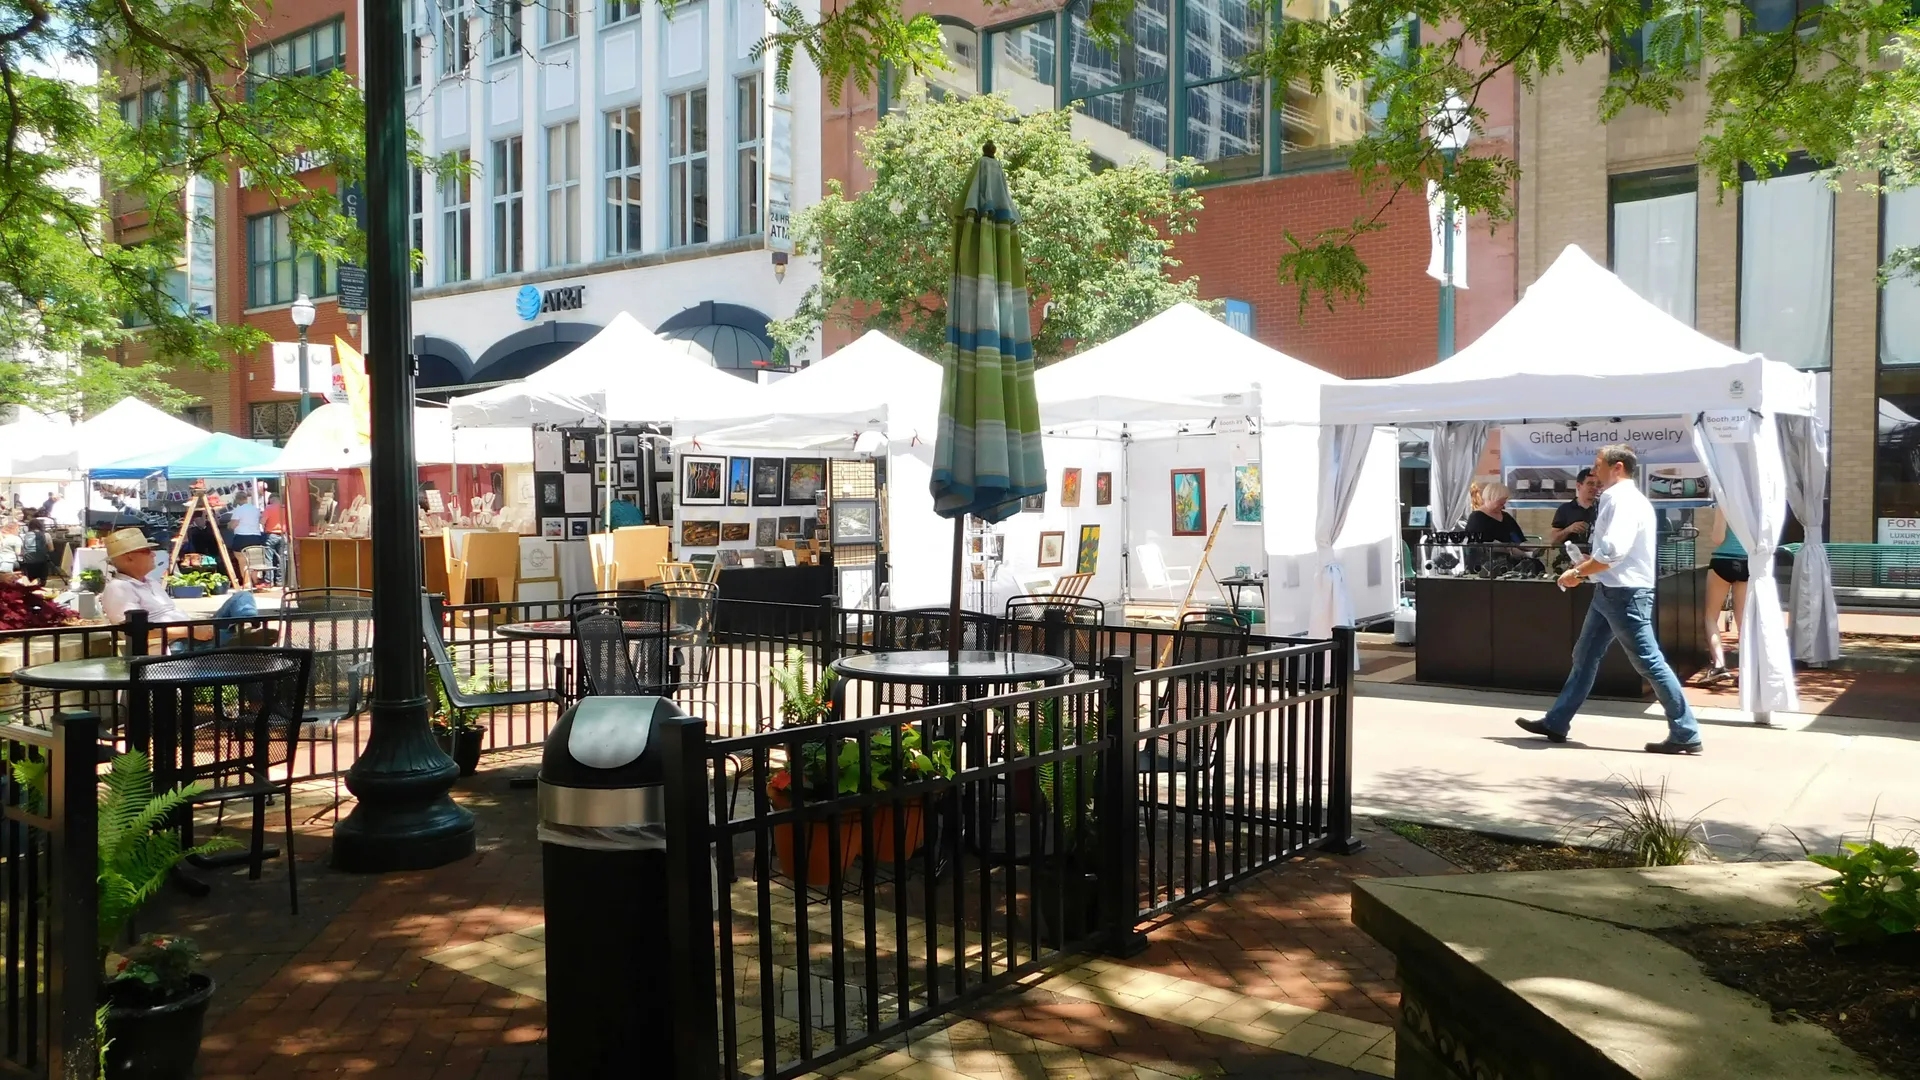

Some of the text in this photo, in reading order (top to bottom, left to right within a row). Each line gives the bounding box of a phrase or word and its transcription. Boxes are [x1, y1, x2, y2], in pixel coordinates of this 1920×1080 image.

[770, 212, 778, 222] 24
[770, 225, 789, 240] ATM
[541, 285, 586, 313] AT&T
[1229, 311, 1248, 333] ATM
[1529, 428, 1683, 444] Gifted Hand Jewelry
[1888, 519, 1916, 528] FOR
